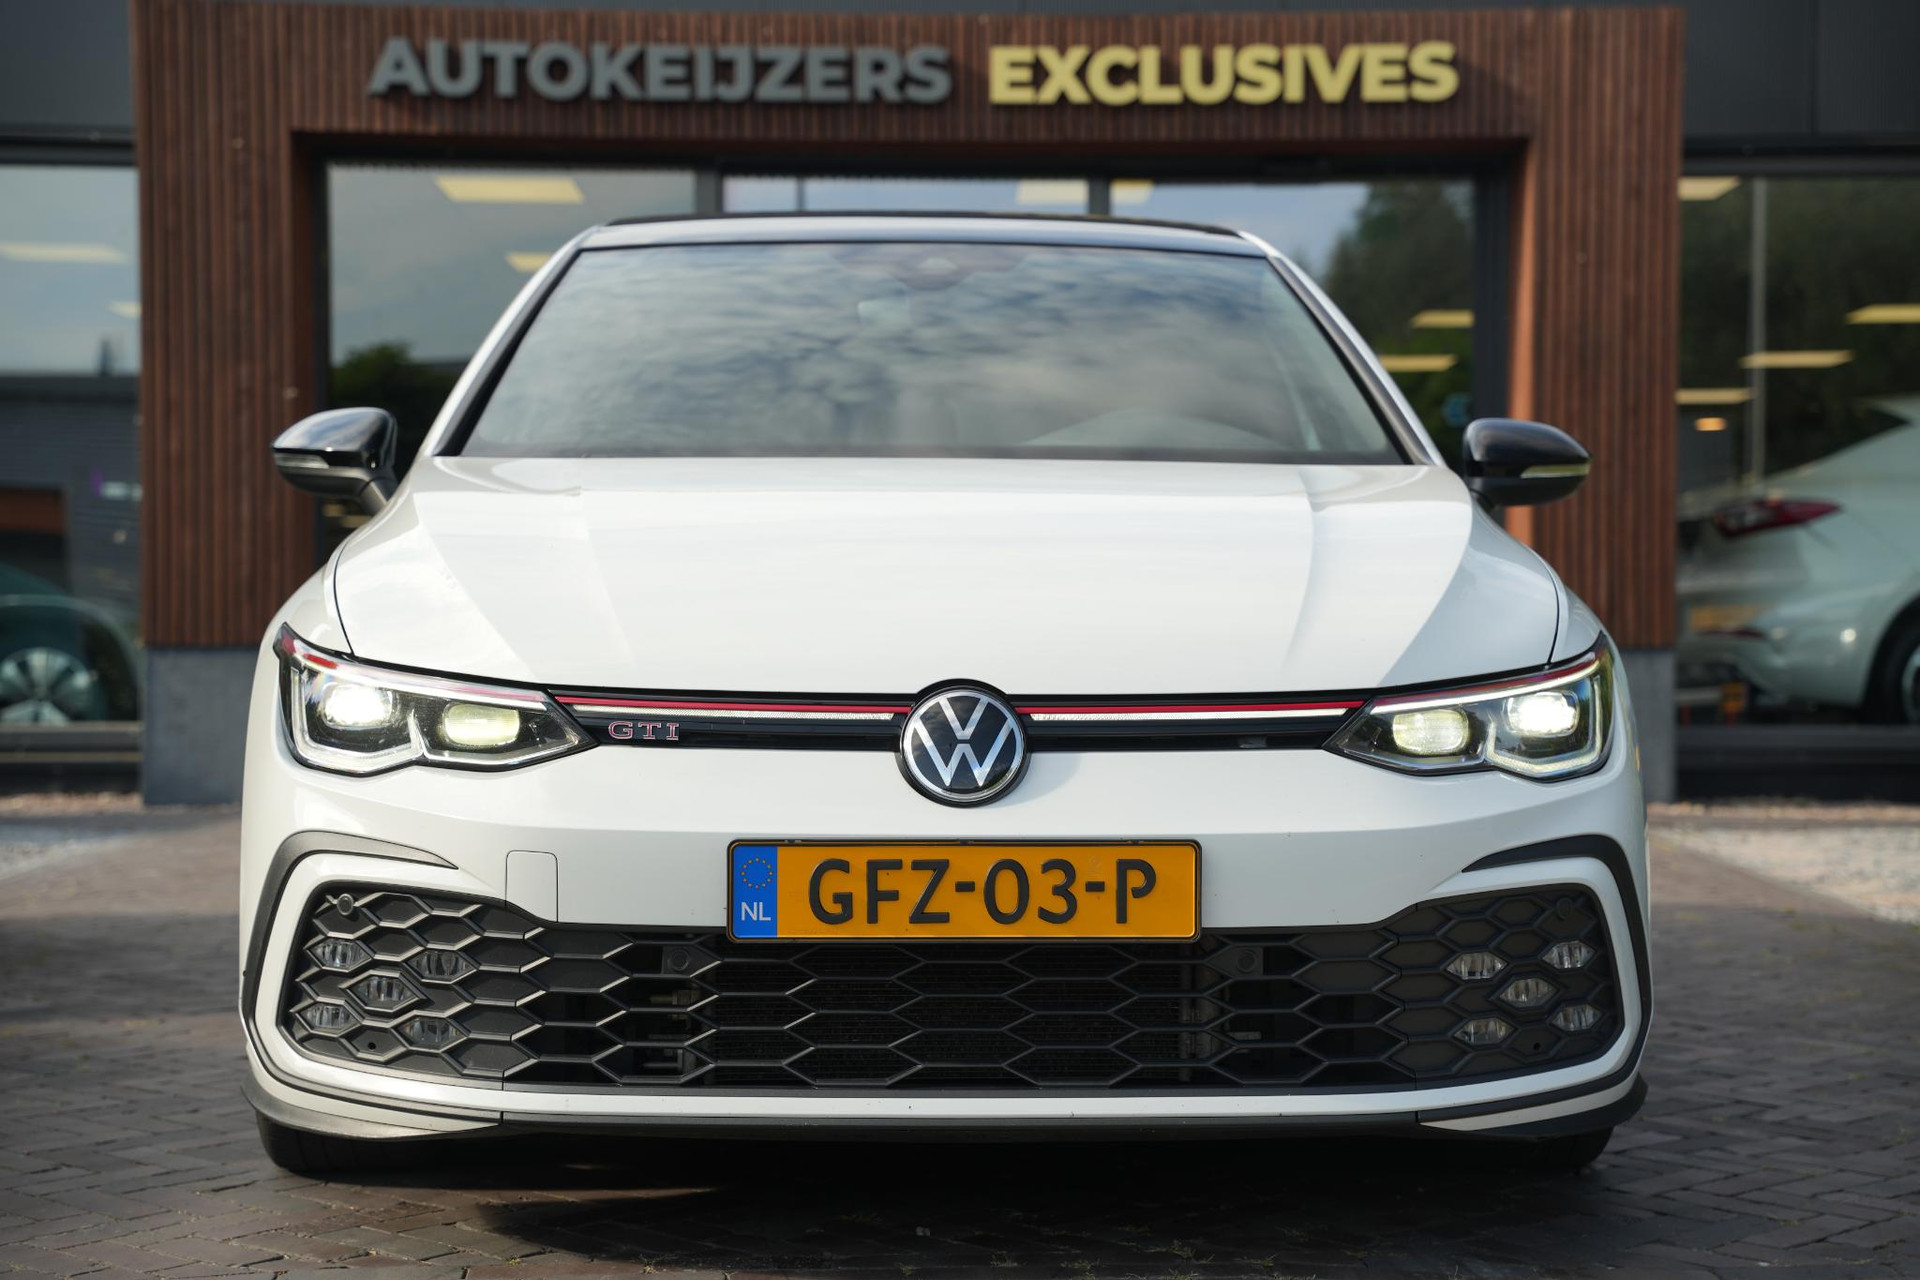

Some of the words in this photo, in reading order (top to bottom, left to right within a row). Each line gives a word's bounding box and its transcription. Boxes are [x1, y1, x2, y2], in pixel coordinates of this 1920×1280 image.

[368, 37, 952, 101] AUTOKEIJZERS
[988, 41, 1460, 104] EXCLUSIVES
[608, 721, 679, 740] GTI
[907, 692, 1017, 789] VW
[740, 901, 771, 922] NL
[808, 858, 1156, 925] GFZ-03-P
